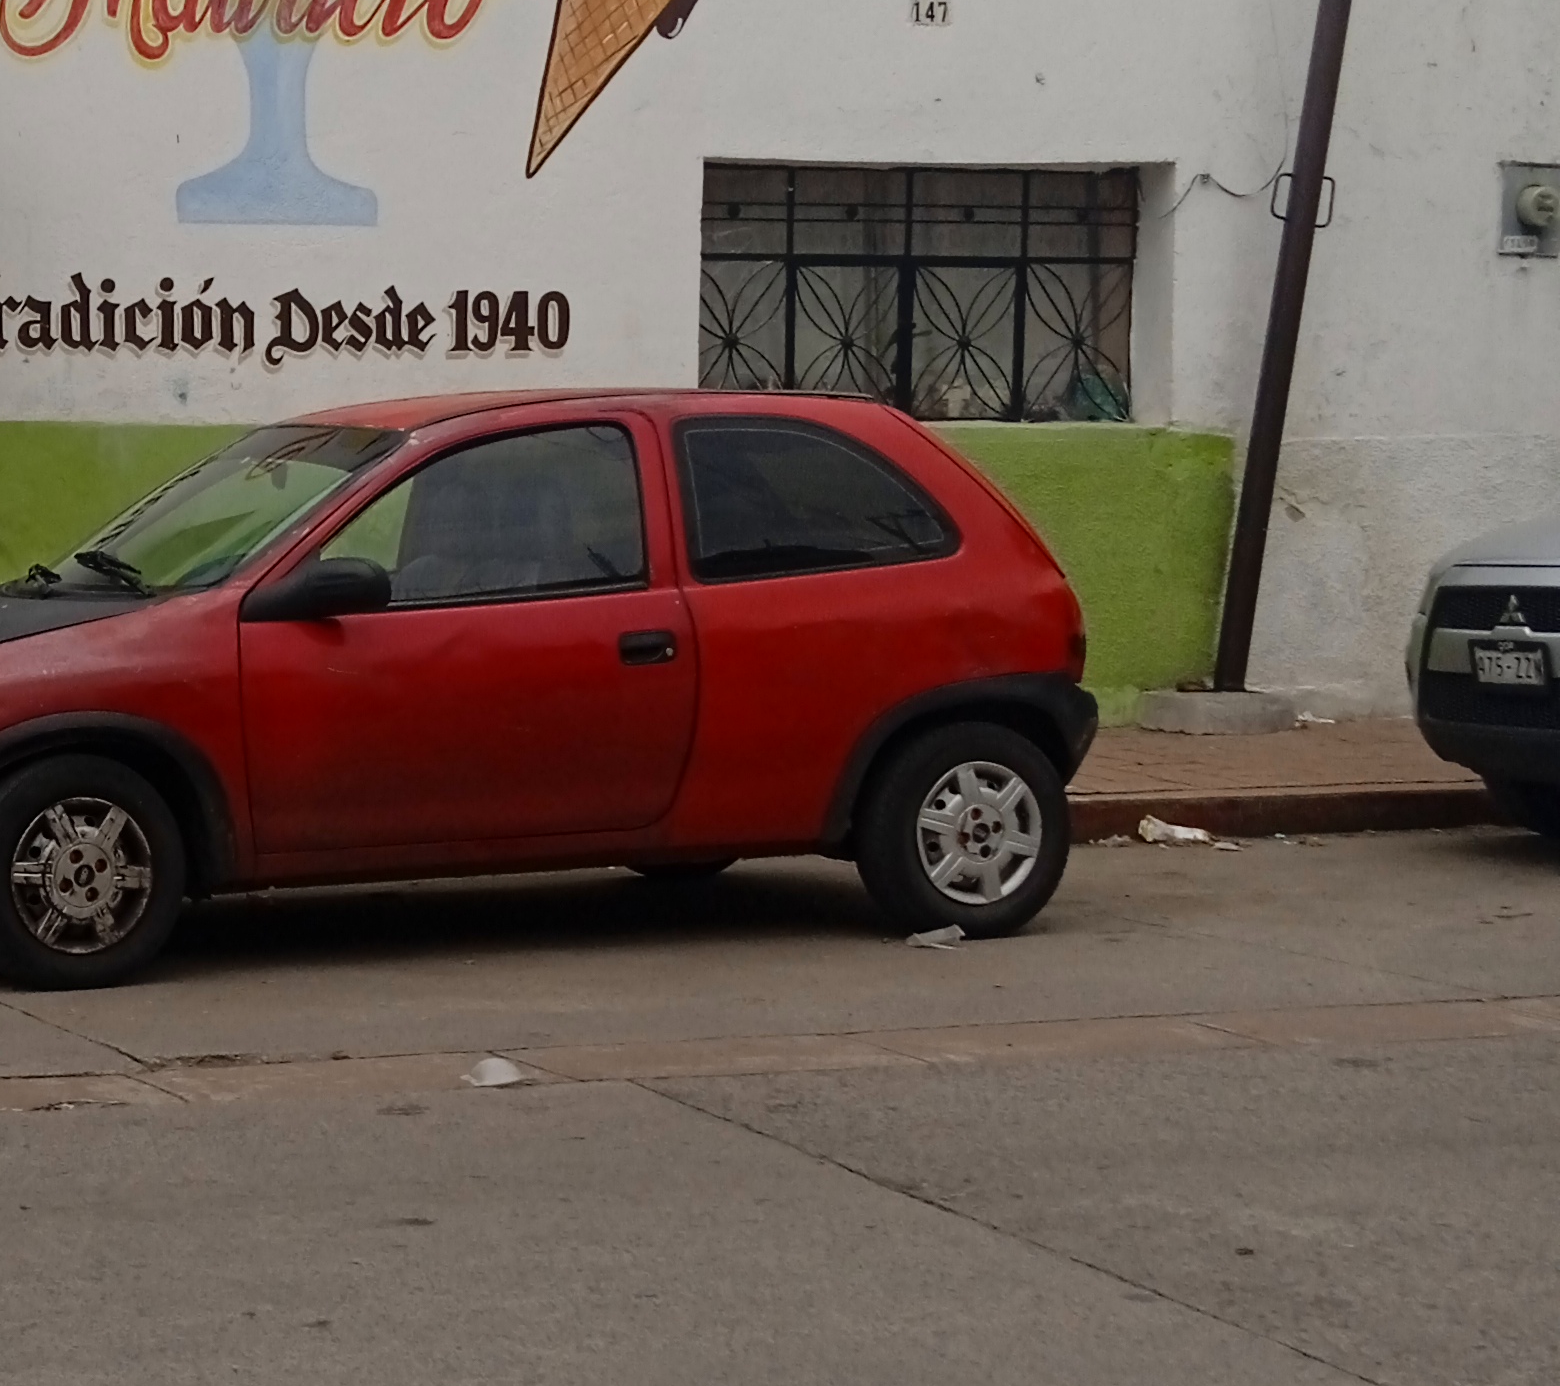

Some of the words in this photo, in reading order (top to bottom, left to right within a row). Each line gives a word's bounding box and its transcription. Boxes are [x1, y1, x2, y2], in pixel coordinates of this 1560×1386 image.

[913, 1, 948, 23] 147
[263, 284, 436, 369] Desde
[446, 289, 572, 353] 1940
